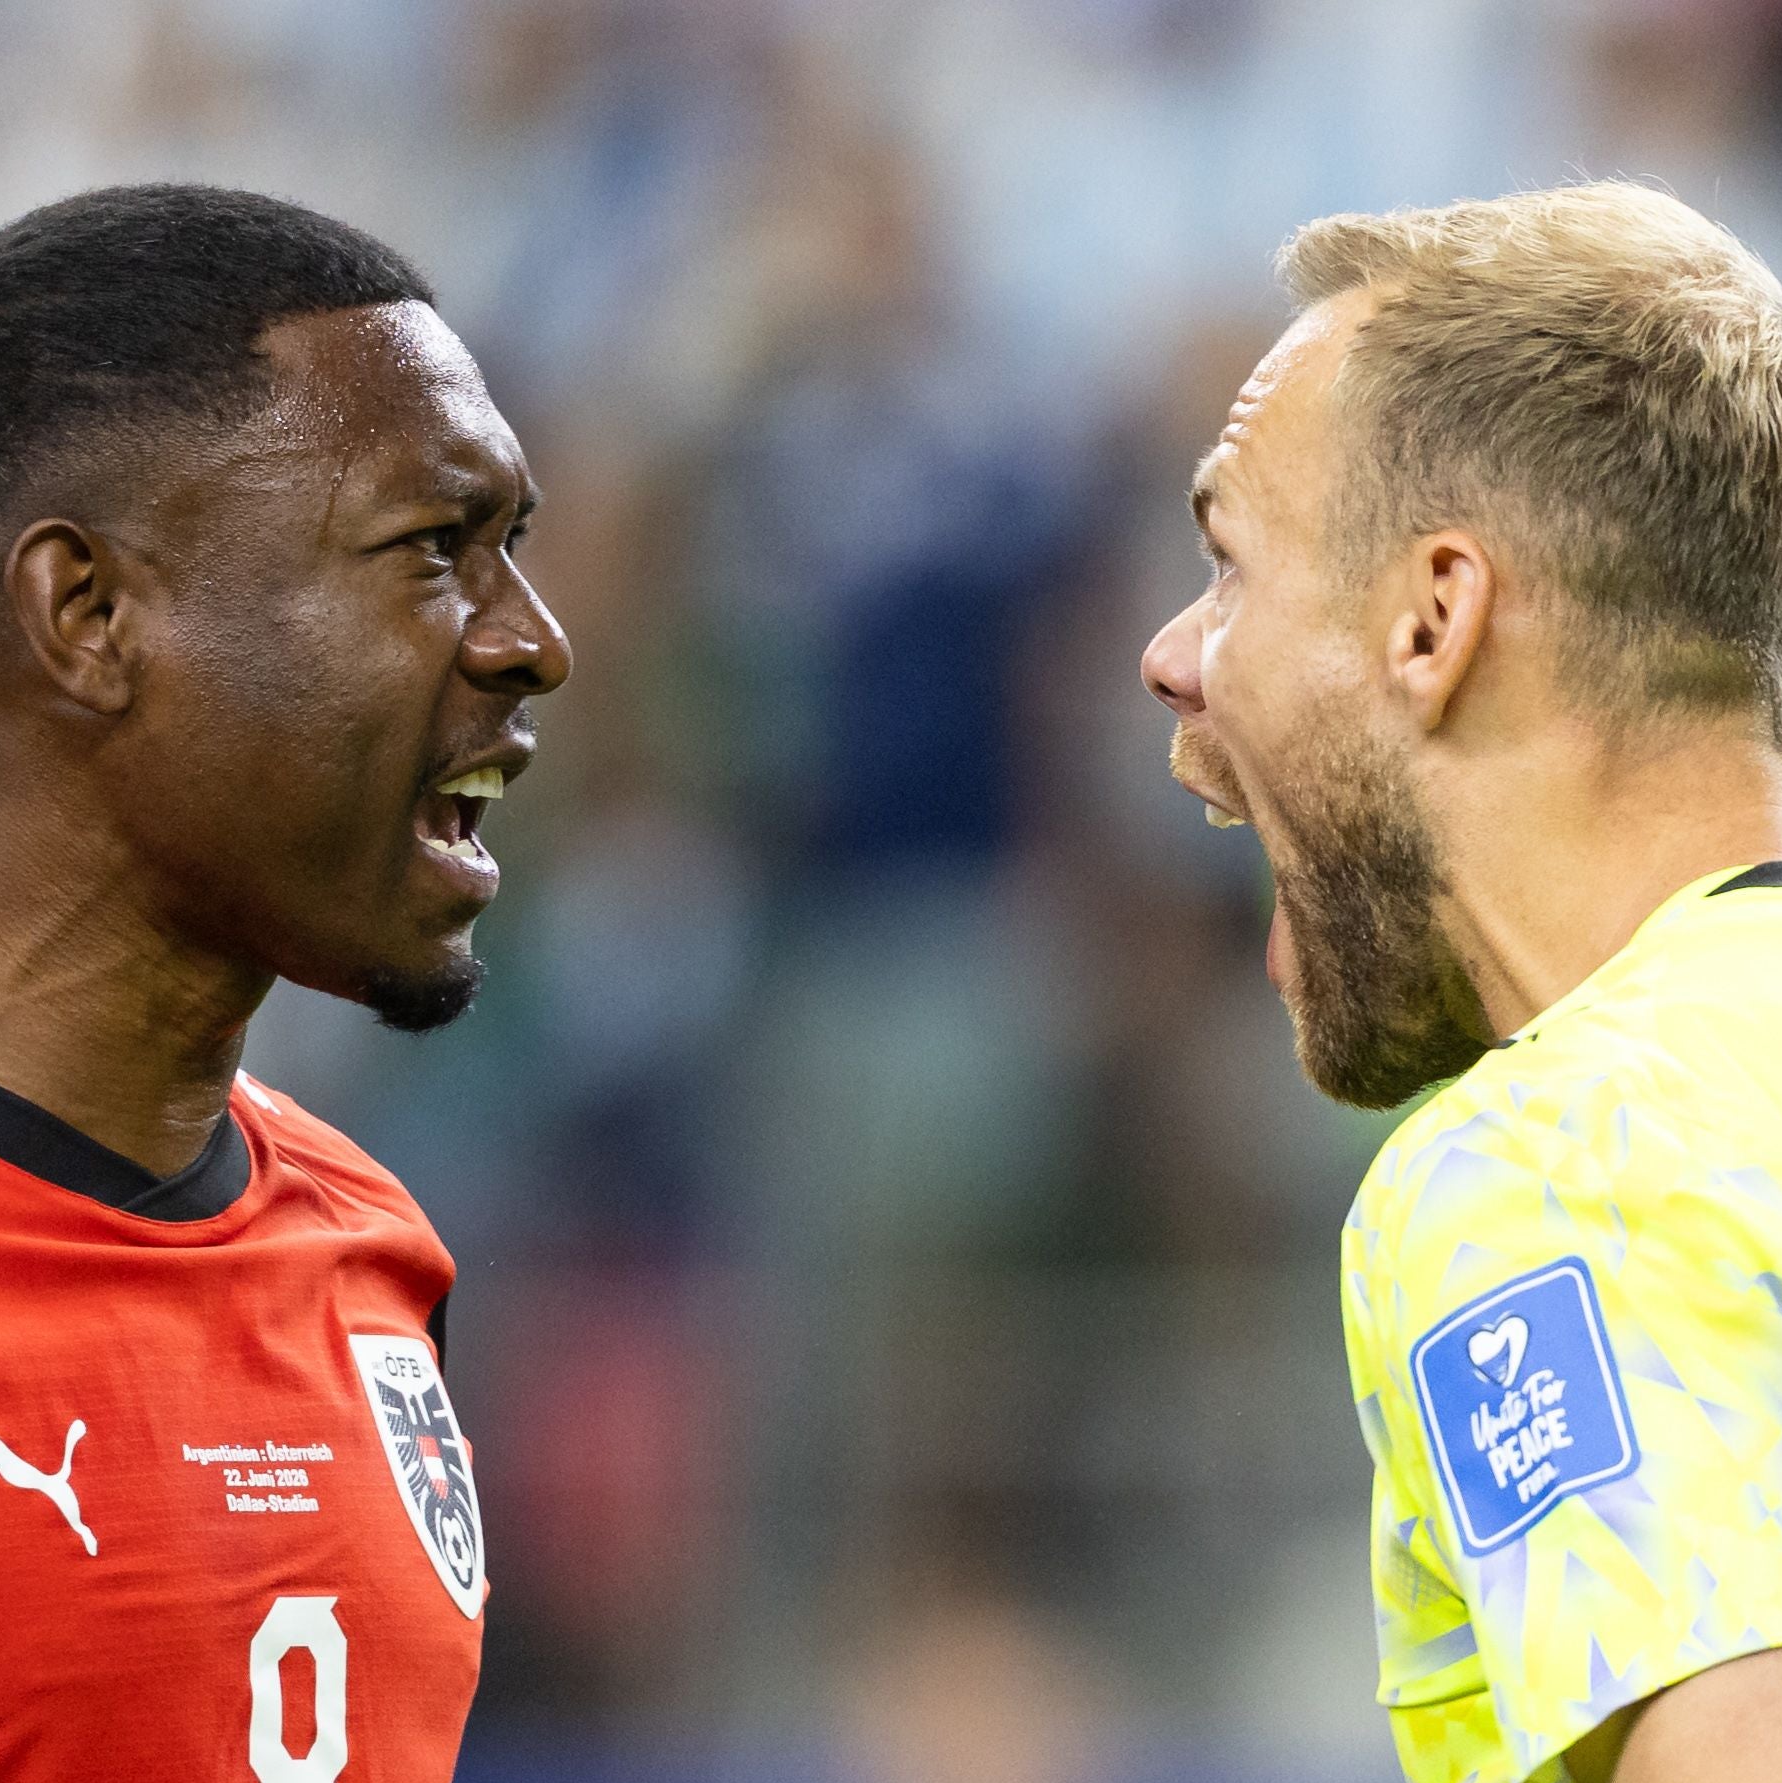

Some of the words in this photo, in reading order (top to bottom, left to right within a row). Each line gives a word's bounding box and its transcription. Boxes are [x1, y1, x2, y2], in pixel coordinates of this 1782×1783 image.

[384, 1351, 422, 1379] ÖFB
[1522, 1368, 1566, 1416] For
[182, 1443, 261, 1465] Argentinien
[266, 1440, 335, 1462] Österreich
[1487, 1407, 1575, 1489] PEACE
[275, 1468, 310, 1487] 2026
[225, 1493, 320, 1512] Dallas-Stadion
